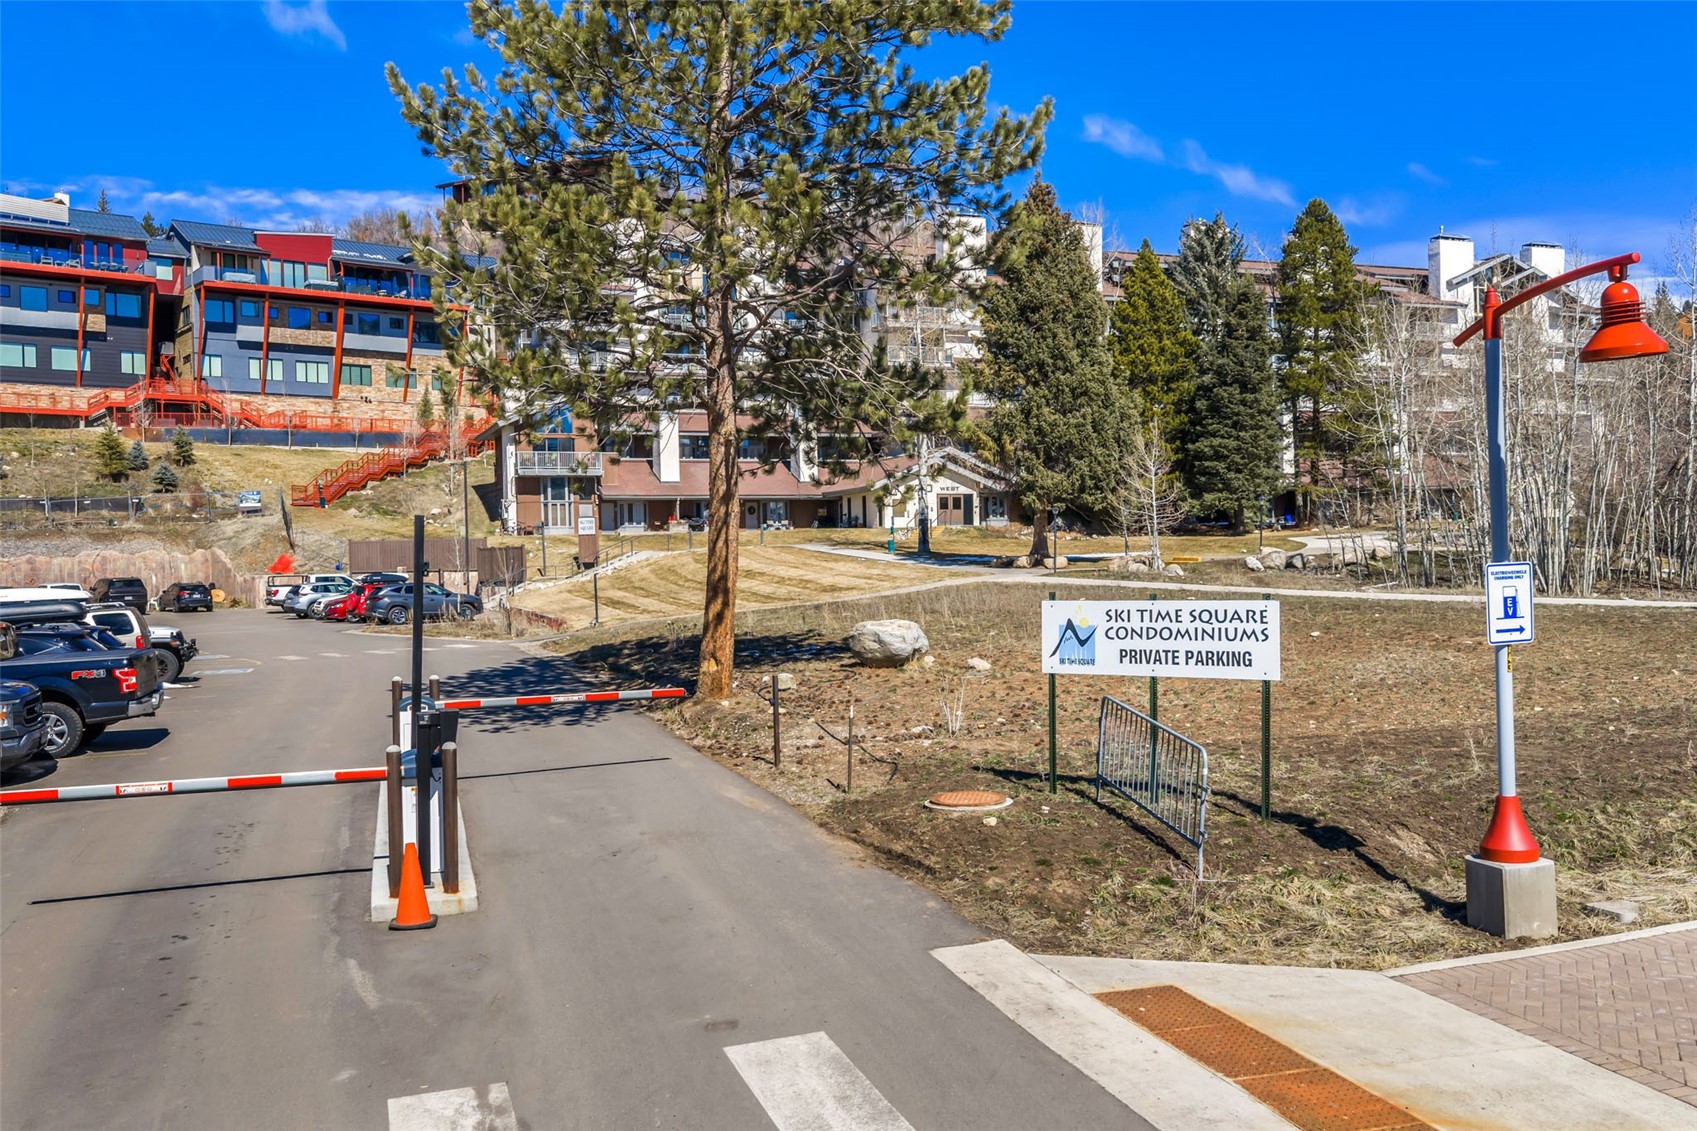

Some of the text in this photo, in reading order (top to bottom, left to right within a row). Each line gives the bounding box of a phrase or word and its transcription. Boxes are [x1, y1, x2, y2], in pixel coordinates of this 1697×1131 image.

[1105, 609, 1269, 626] SKI TIME SQUARE
[1104, 626, 1269, 643] CONDOMINIUMS
[1078, 658, 1095, 666] SQUARE
[1119, 649, 1253, 668] PRIVATE PARKING
[71, 669, 106, 680] FX4
